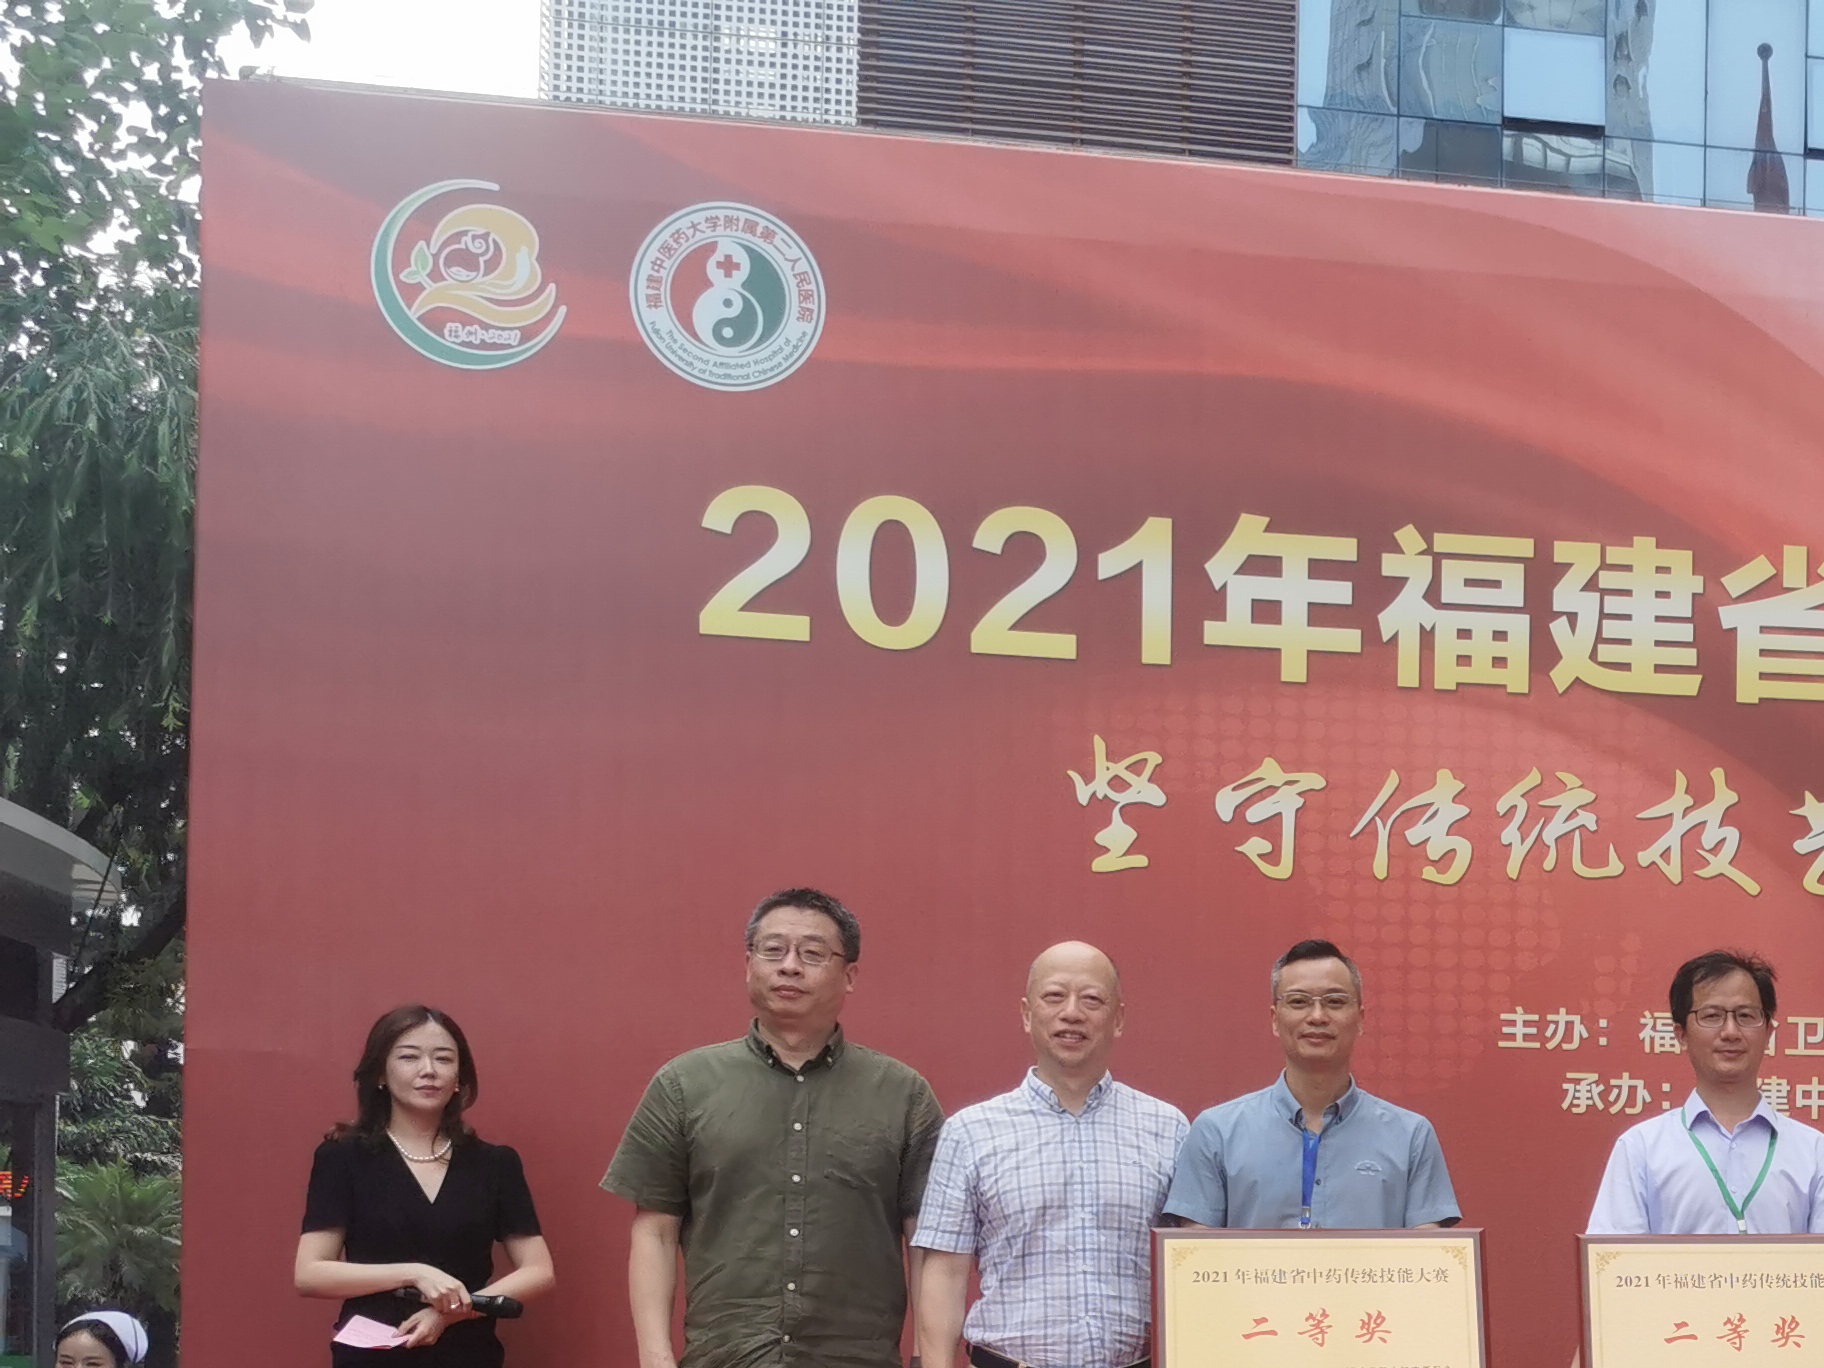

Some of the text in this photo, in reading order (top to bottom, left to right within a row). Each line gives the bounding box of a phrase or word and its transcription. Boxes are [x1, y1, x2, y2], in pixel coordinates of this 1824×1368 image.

[645, 214, 815, 324] 福建中医药大学附属第二人民医院
[678, 343, 710, 366] Second
[752, 345, 785, 366] Hospital
[752, 361, 783, 379] Chinese
[1192, 1267, 1449, 1285] 2021年福建省中药传统技能大赛
[1241, 1307, 1393, 1348] 二等奖
[1663, 1312, 1806, 1353] 二等奖
